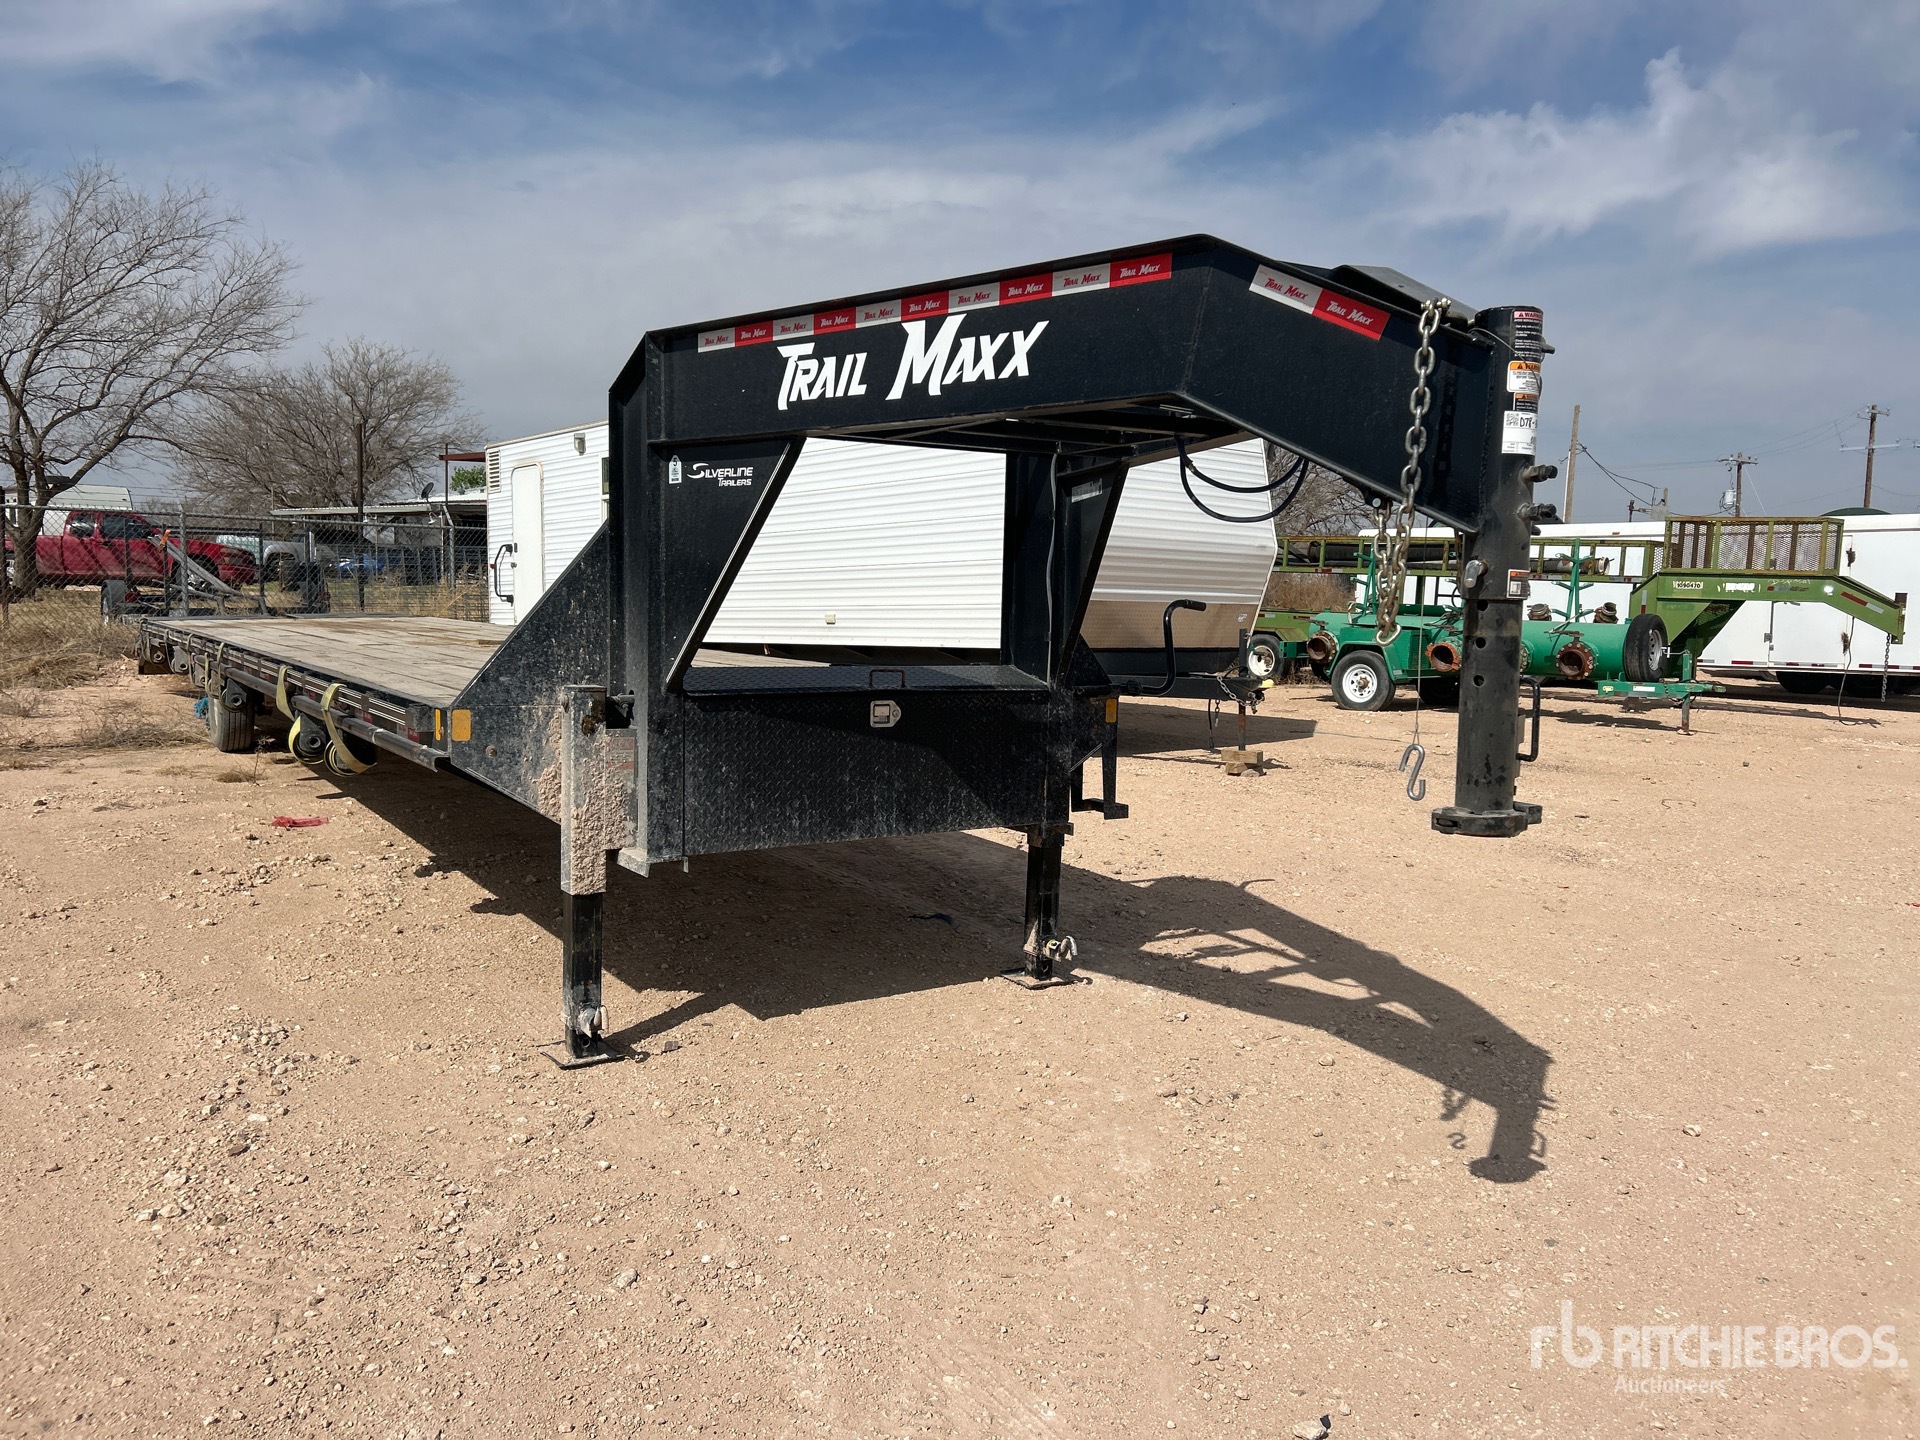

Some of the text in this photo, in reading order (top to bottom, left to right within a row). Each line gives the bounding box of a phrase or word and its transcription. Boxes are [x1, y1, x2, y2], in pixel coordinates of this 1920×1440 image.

[1120, 264, 1160, 278] TRAIL MAXX
[1264, 278, 1308, 300] TRAIL MAXX
[1327, 301, 1373, 325] TRAIL MAXX
[777, 314, 1049, 410] TRAIL MAXX
[718, 478, 752, 486] TRAILERS
